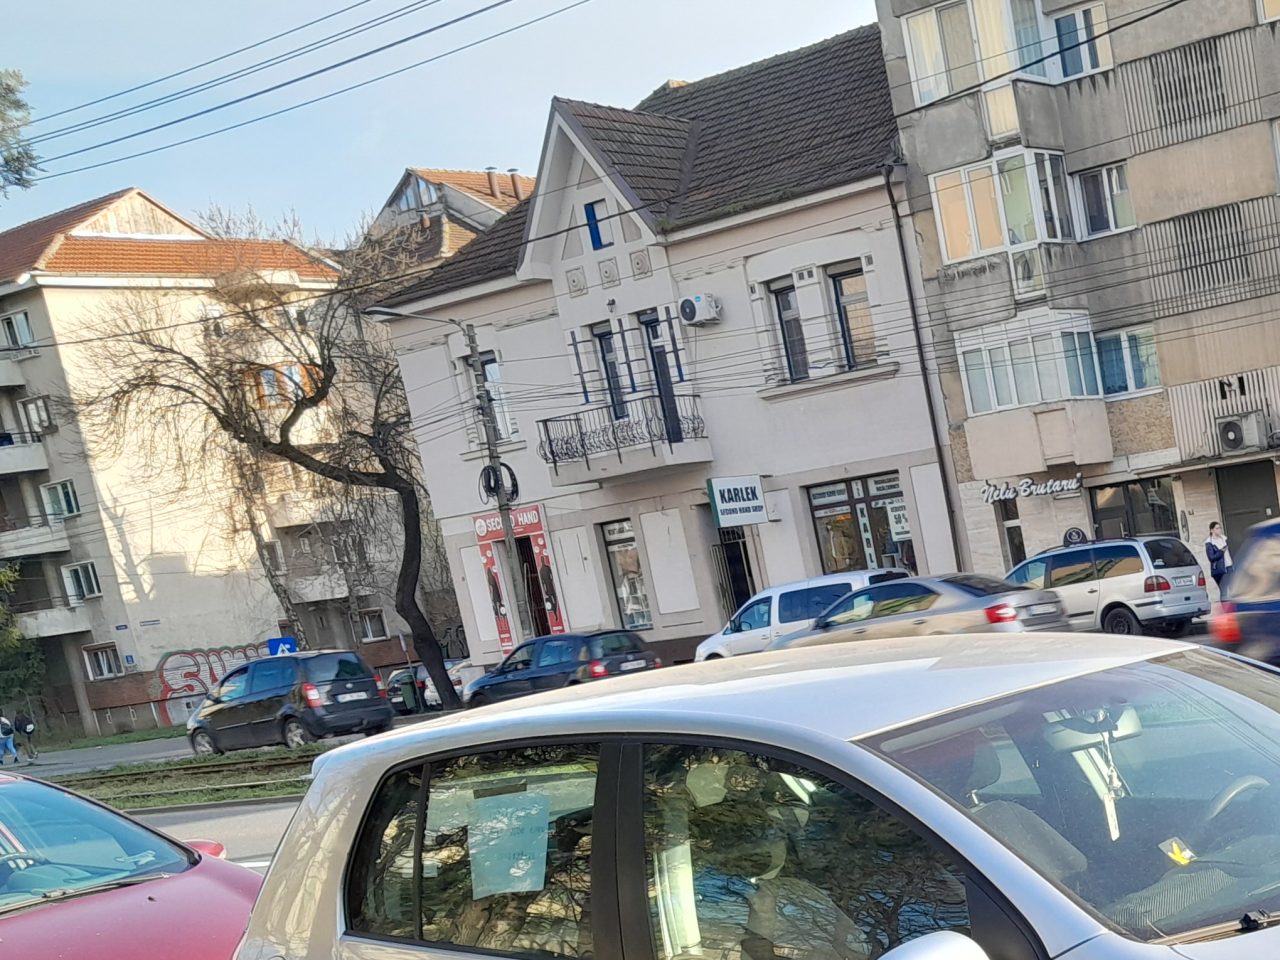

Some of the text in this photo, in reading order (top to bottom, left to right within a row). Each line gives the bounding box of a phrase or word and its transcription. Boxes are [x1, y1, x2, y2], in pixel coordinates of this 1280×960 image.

[719, 486, 758, 504] KARLEK
[981, 481, 1018, 504] Nelu
[486, 510, 538, 531] SECD HAND
[859, 507, 876, 569] KARL
